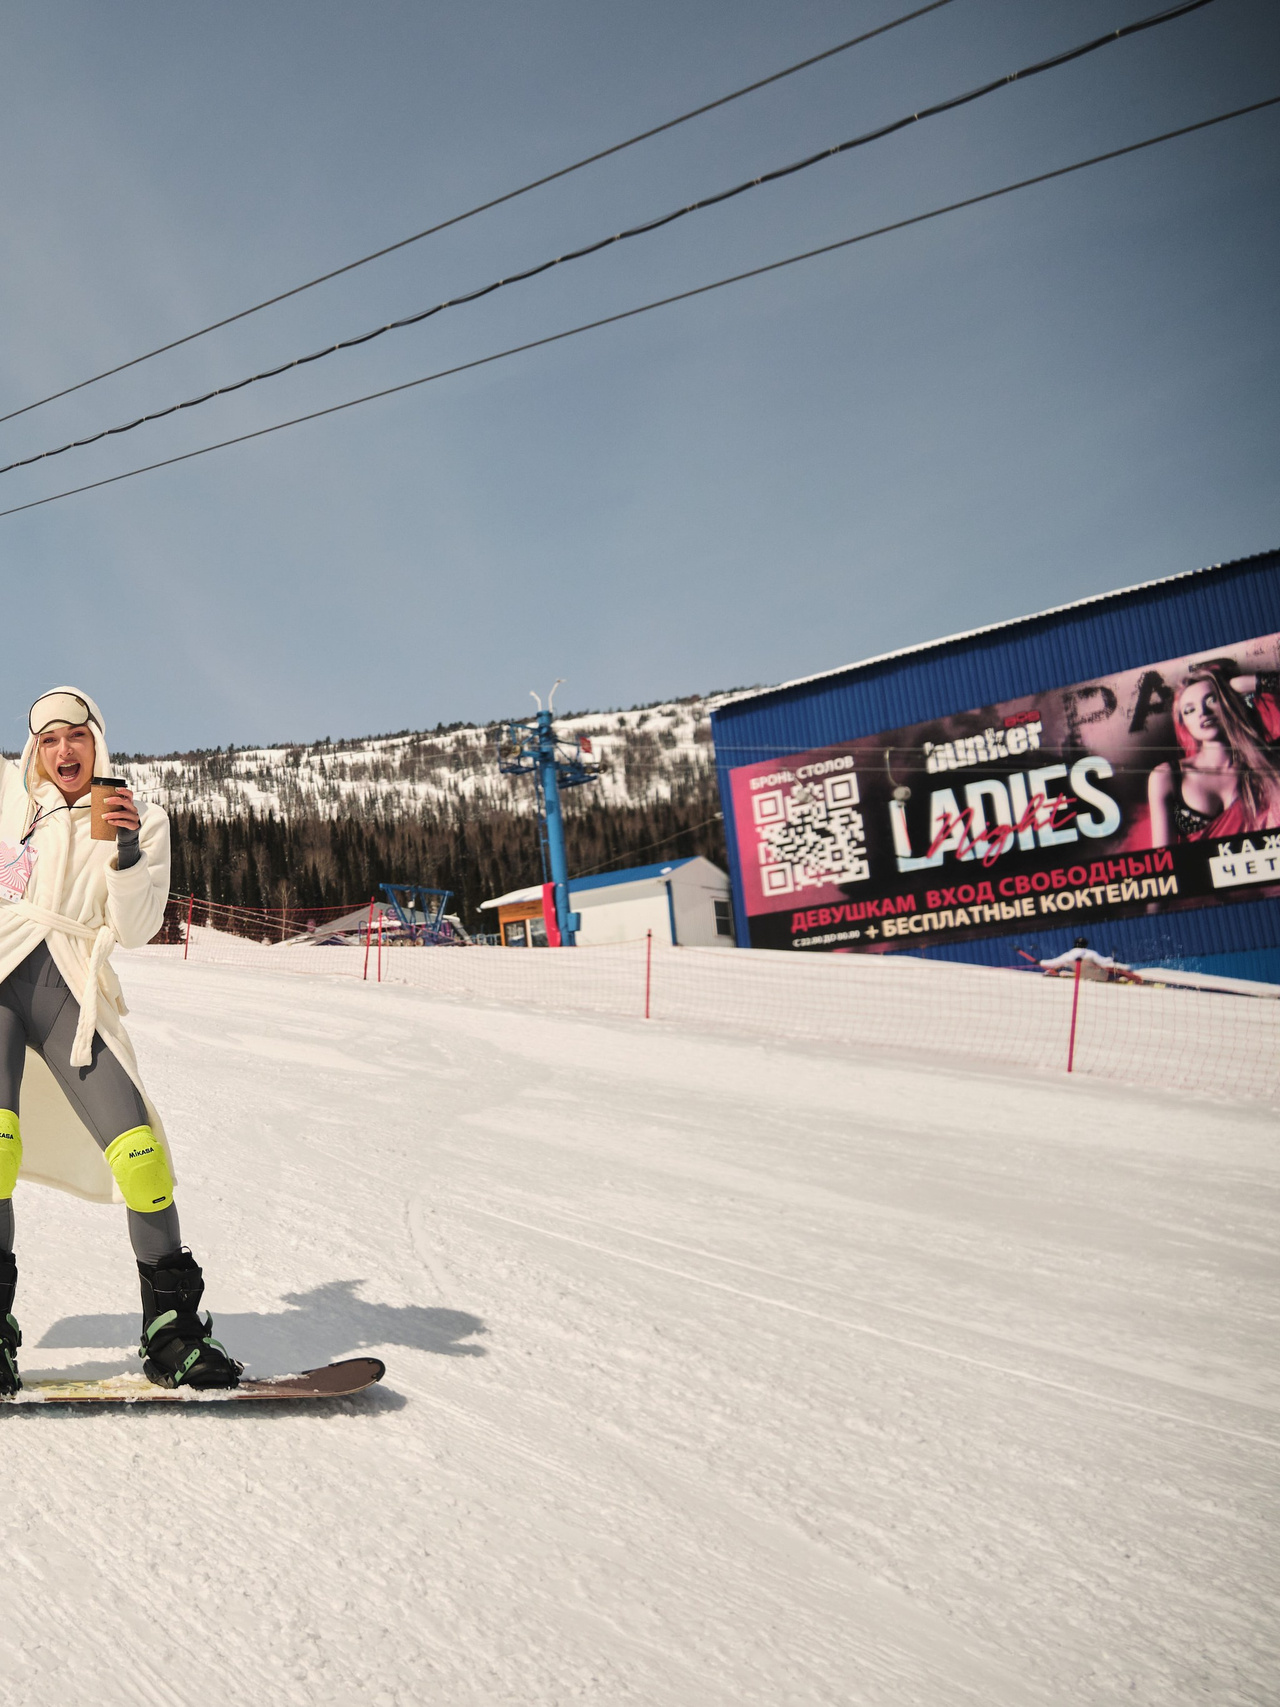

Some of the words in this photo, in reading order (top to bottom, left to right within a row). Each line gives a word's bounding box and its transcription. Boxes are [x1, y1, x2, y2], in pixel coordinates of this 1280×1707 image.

[749, 771, 795, 790] БРОНЬ
[796, 755, 855, 779] СТОЛОВ
[889, 756, 1121, 873] LADIES
[926, 792, 1078, 868] Night
[791, 894, 917, 934] ДЕВУШКАМ
[926, 881, 996, 909] ВХОД
[999, 848, 1174, 896] СВОБОДНЫЙ
[1222, 856, 1277, 877] ЧЕТ
[881, 897, 1036, 938] БЕСПЛАТНЫЕ
[1040, 875, 1179, 914] КОКТЕЙЛИ
